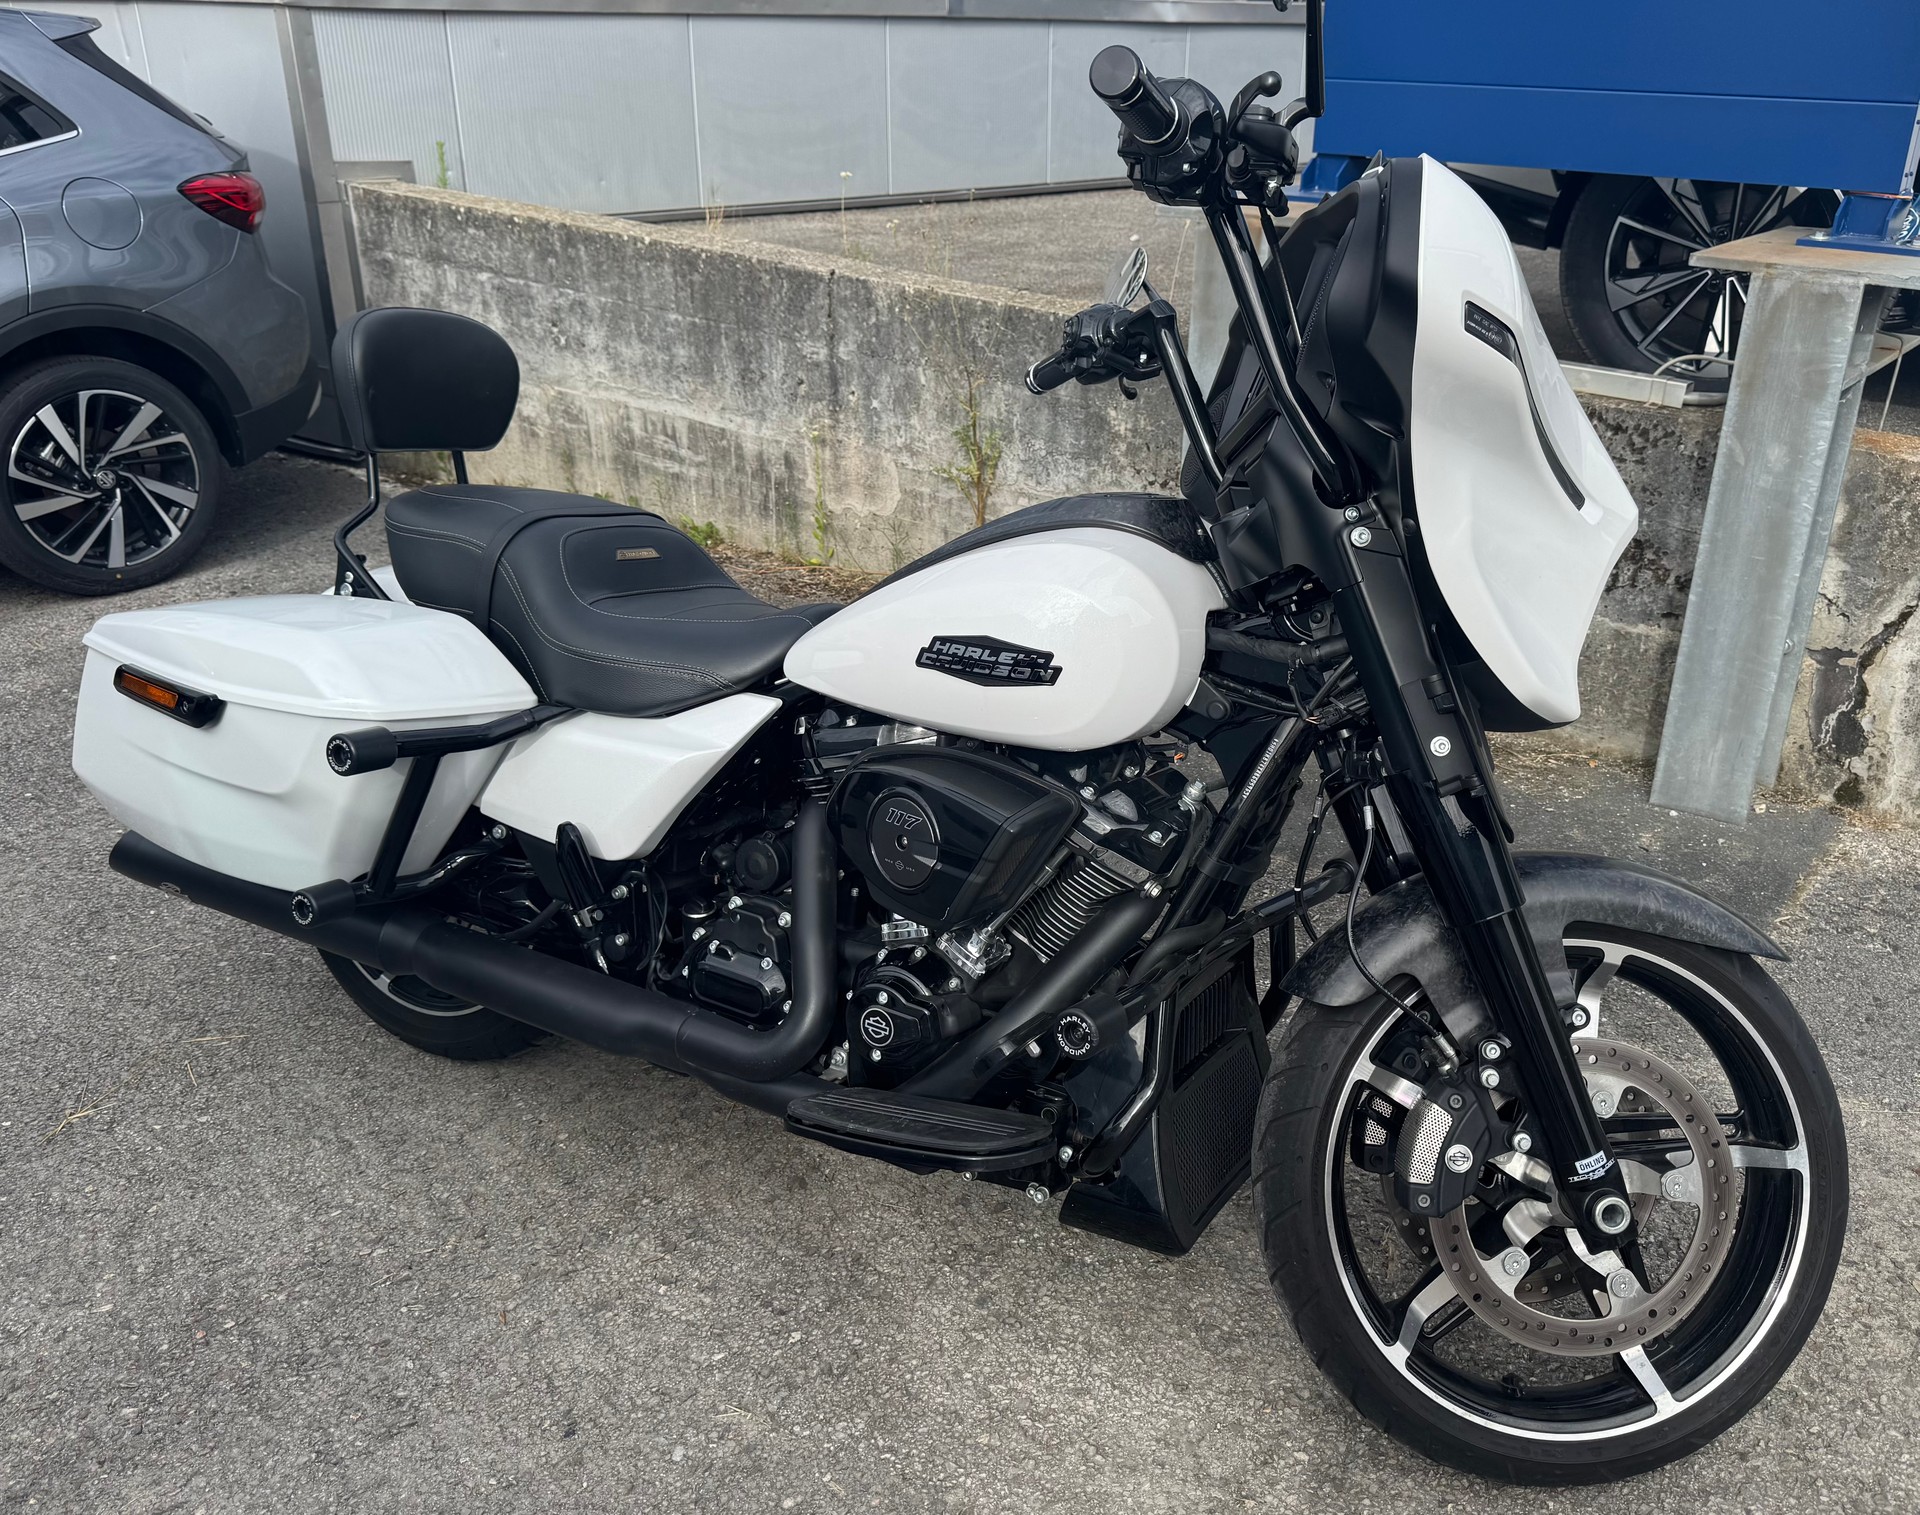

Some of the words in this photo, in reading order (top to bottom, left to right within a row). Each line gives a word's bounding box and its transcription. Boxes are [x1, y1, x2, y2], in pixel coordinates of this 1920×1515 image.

[919, 652, 1054, 682] DAVIDSON
[885, 807, 923, 830] 117
[1060, 1015, 1091, 1034] HARLEY
[1056, 1033, 1091, 1056] DAVIDSON
[1578, 1154, 1606, 1172] ÖHLINS
